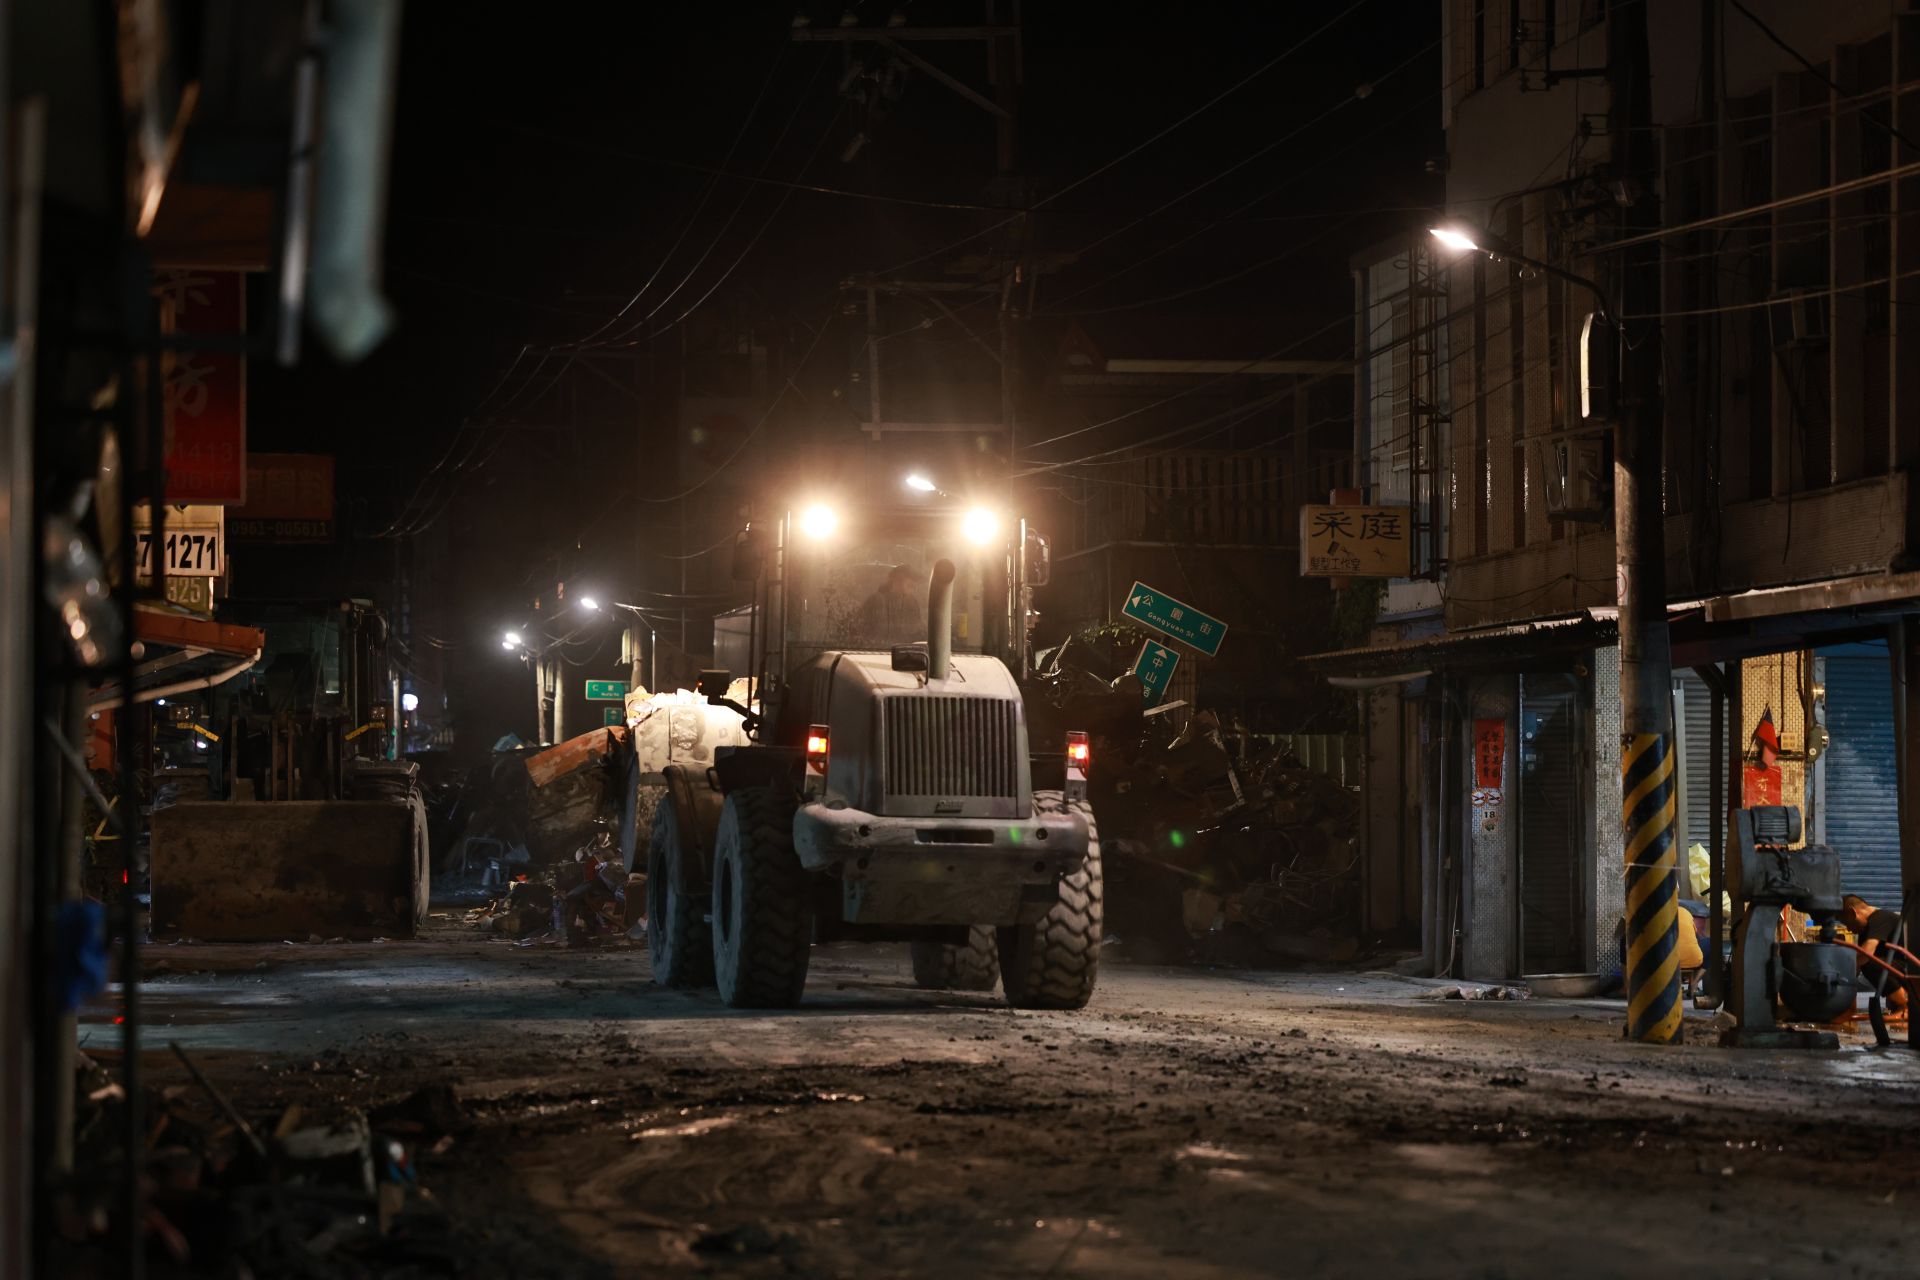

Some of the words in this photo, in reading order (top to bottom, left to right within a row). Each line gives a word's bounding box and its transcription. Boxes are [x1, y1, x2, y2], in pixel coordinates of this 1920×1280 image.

[1147, 611, 1184, 634] Gongyuan
[1185, 630, 1195, 639] St
[1484, 811, 1496, 819] 18
